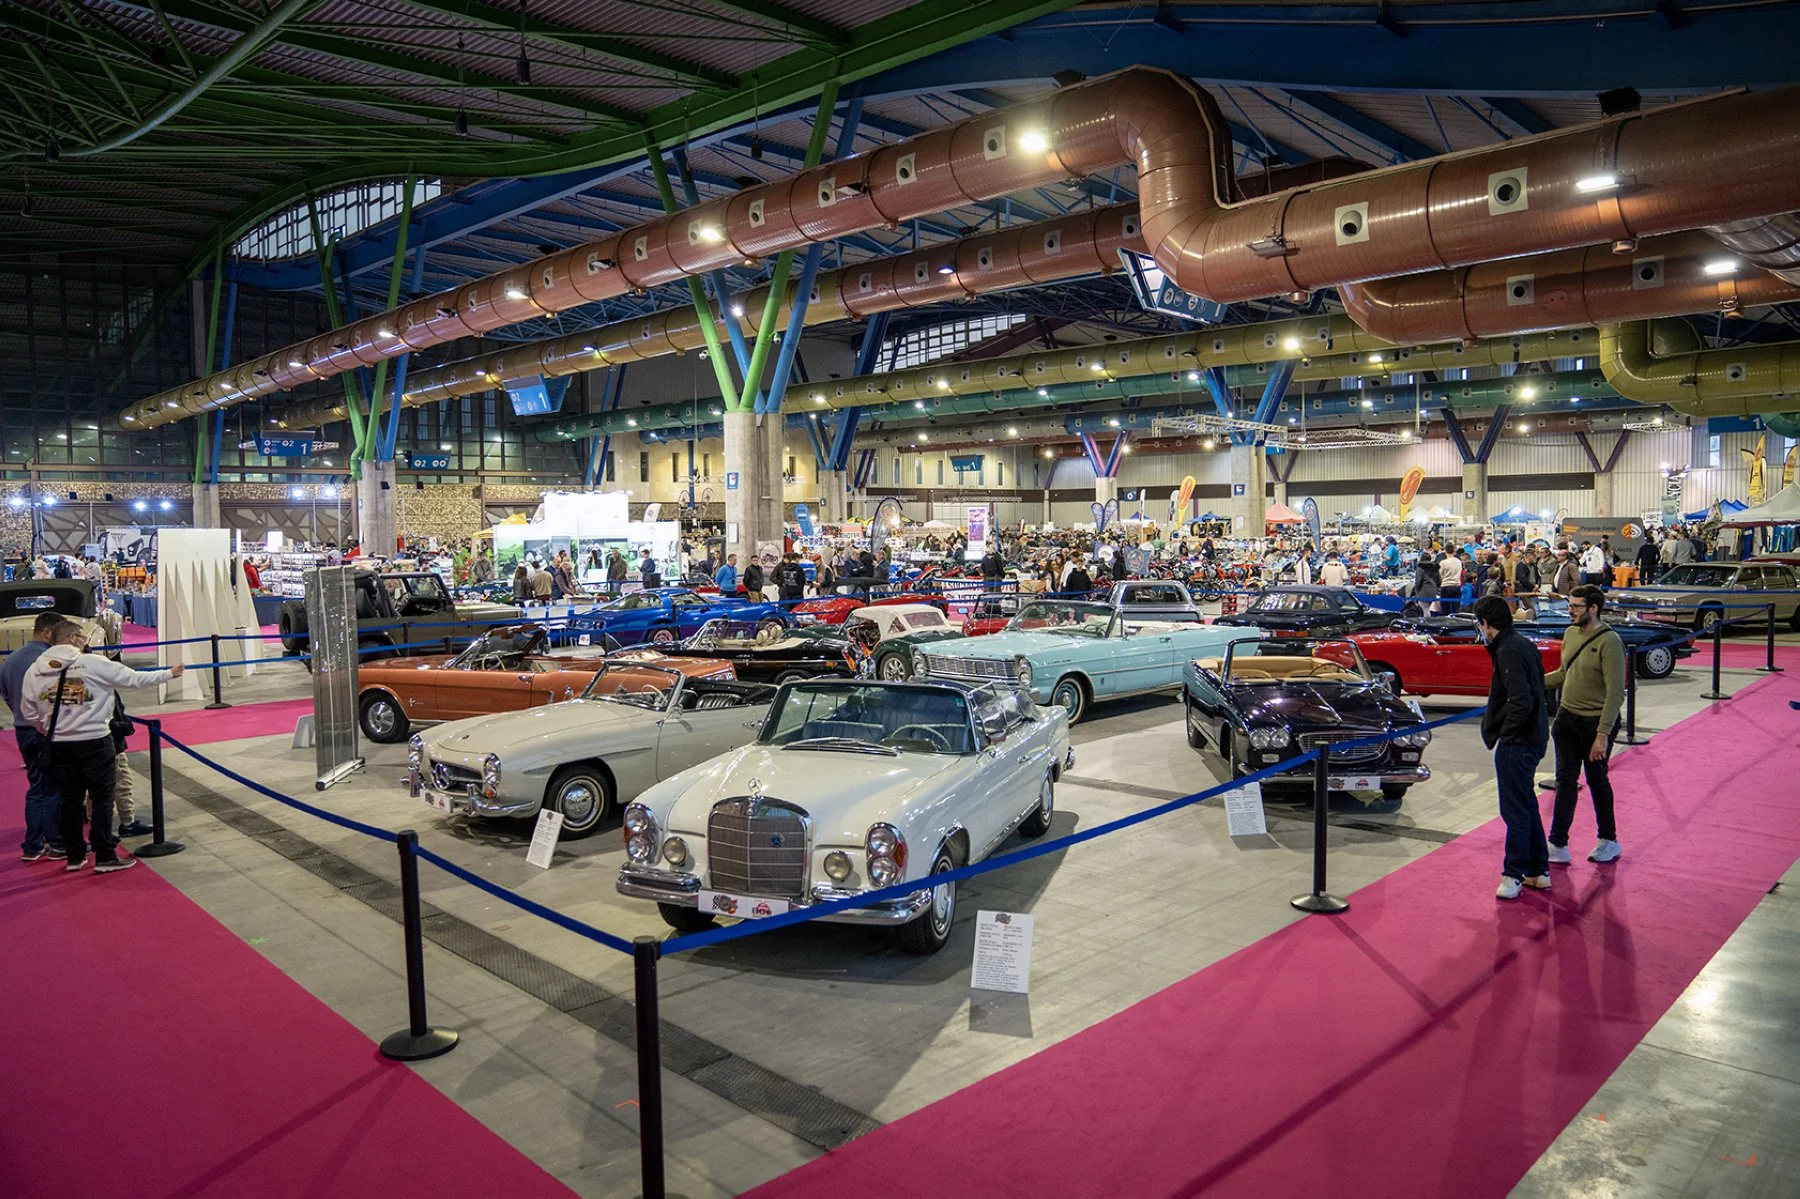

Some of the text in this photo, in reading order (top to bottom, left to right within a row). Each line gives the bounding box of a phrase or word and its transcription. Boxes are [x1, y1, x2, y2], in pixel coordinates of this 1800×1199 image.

[538, 392, 547, 409] 1
[1752, 417, 1761, 429] 1
[300, 443, 308, 455] 1
[421, 459, 427, 468] 2
